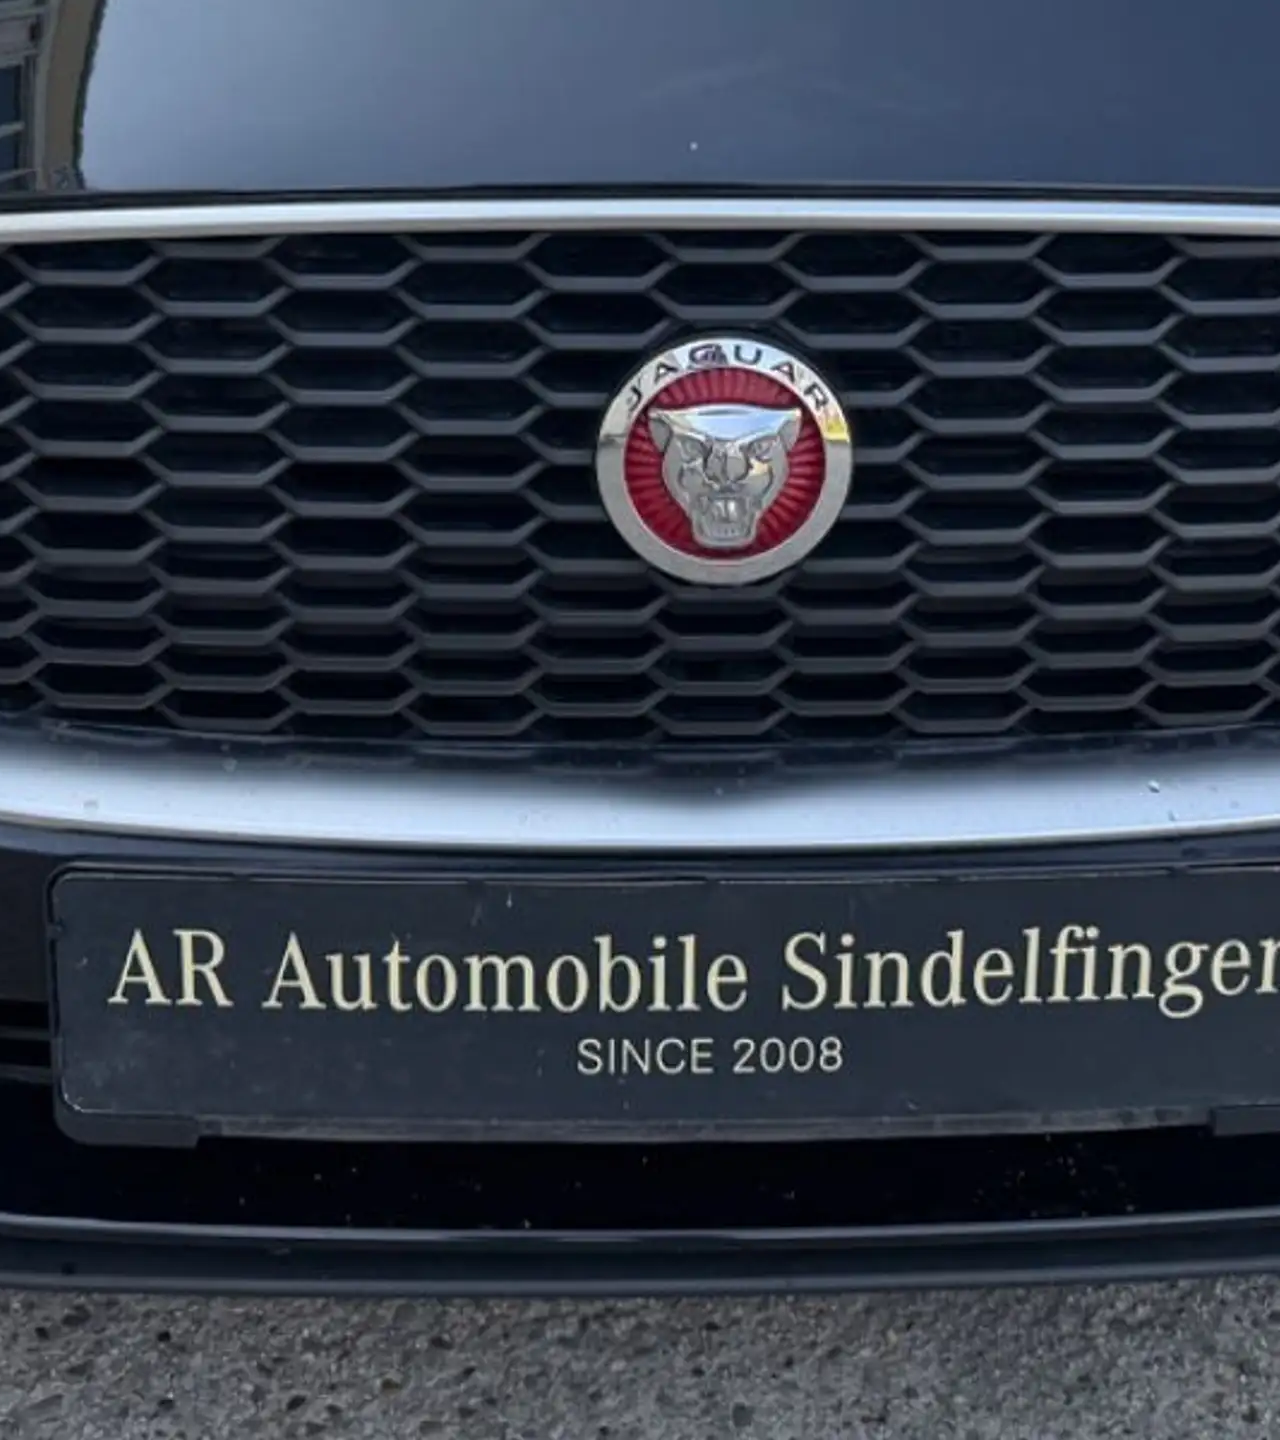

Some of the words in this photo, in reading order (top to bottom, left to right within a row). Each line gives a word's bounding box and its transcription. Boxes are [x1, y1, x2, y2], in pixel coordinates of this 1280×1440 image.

[627, 343, 828, 411] JAGUAR
[106, 928, 235, 1009] AR
[260, 931, 749, 1014] Automobile
[577, 1037, 715, 1075] SINCE
[731, 1036, 844, 1075] 2008
